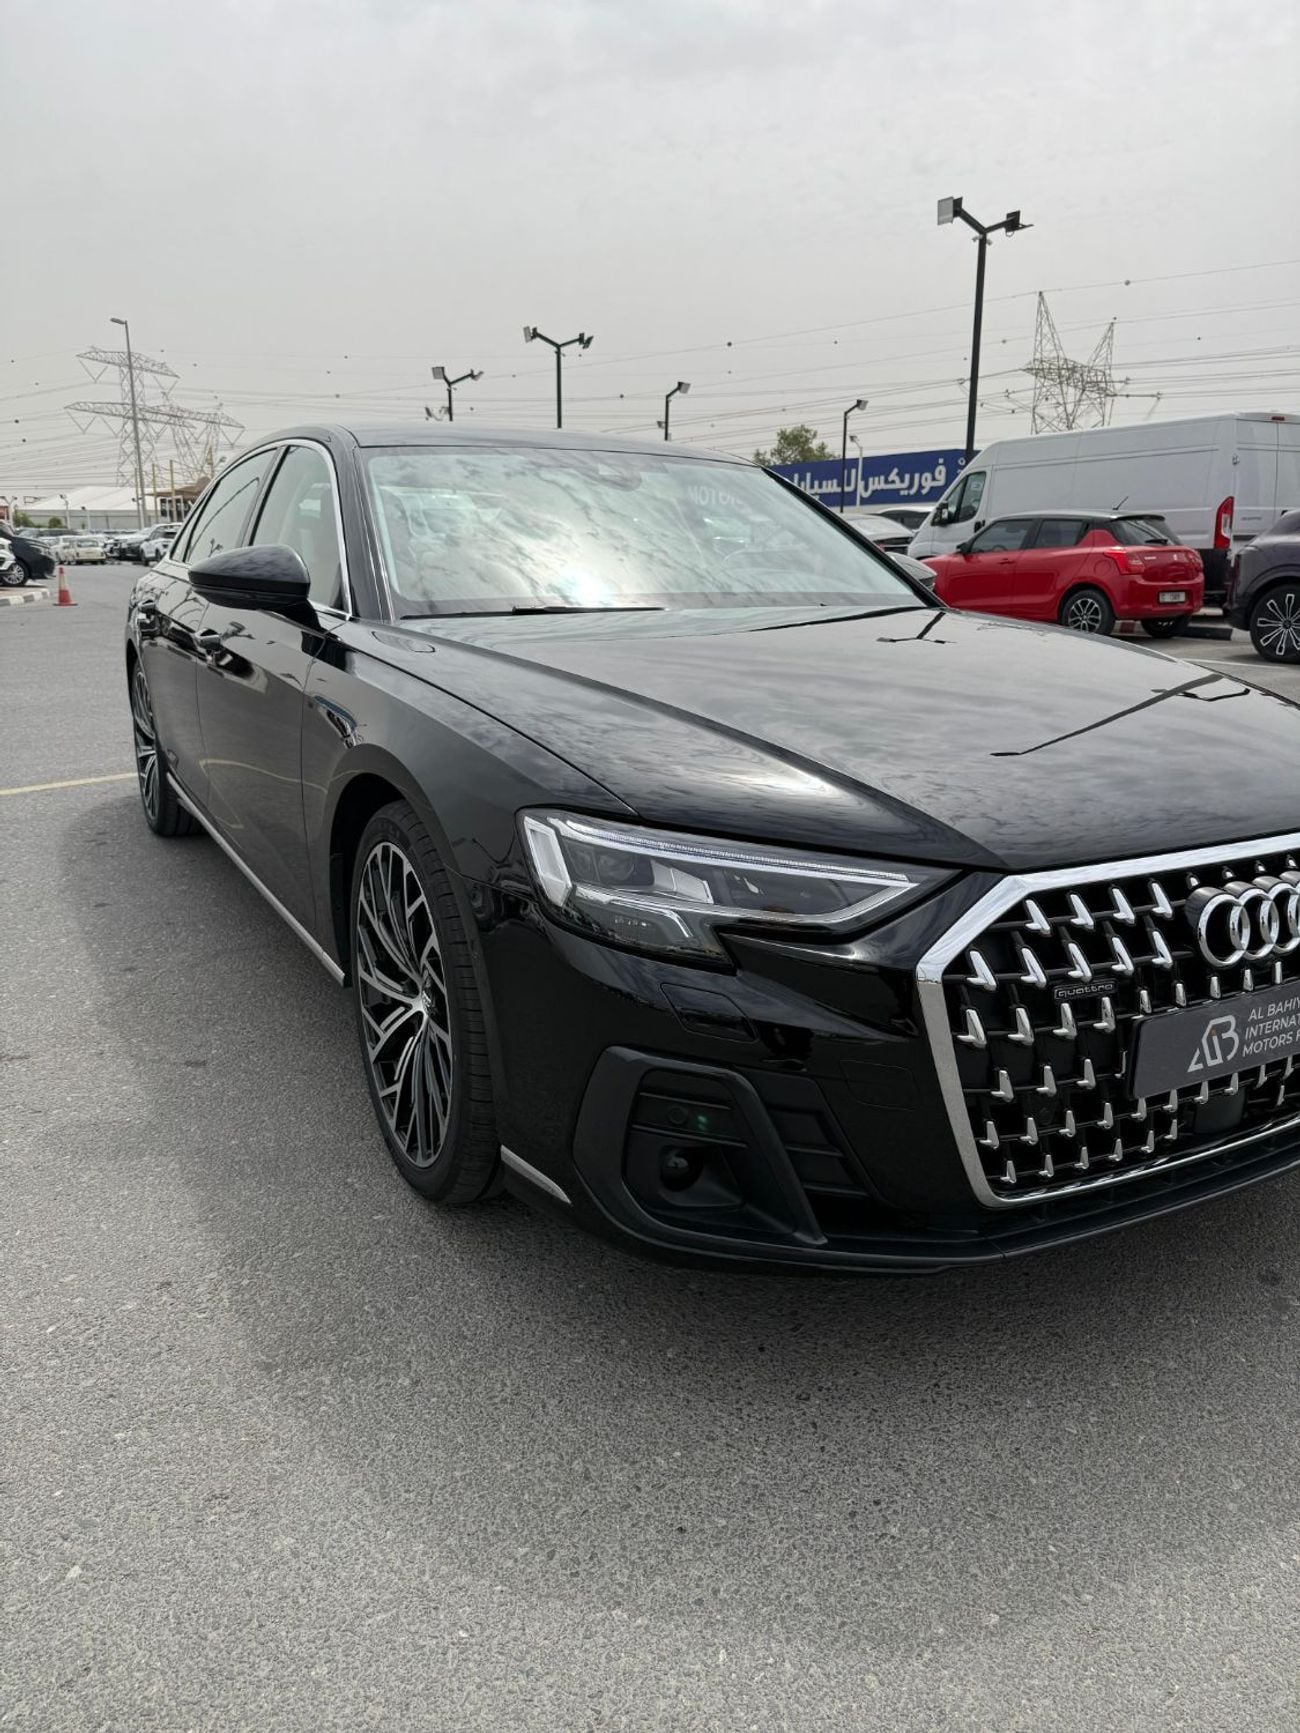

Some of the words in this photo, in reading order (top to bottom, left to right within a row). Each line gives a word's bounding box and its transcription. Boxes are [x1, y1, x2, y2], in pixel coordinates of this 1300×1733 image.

[860, 457, 948, 498] فوريكس
[1247, 1006, 1264, 1022] AL
[1242, 1031, 1293, 1057] MOTORS
